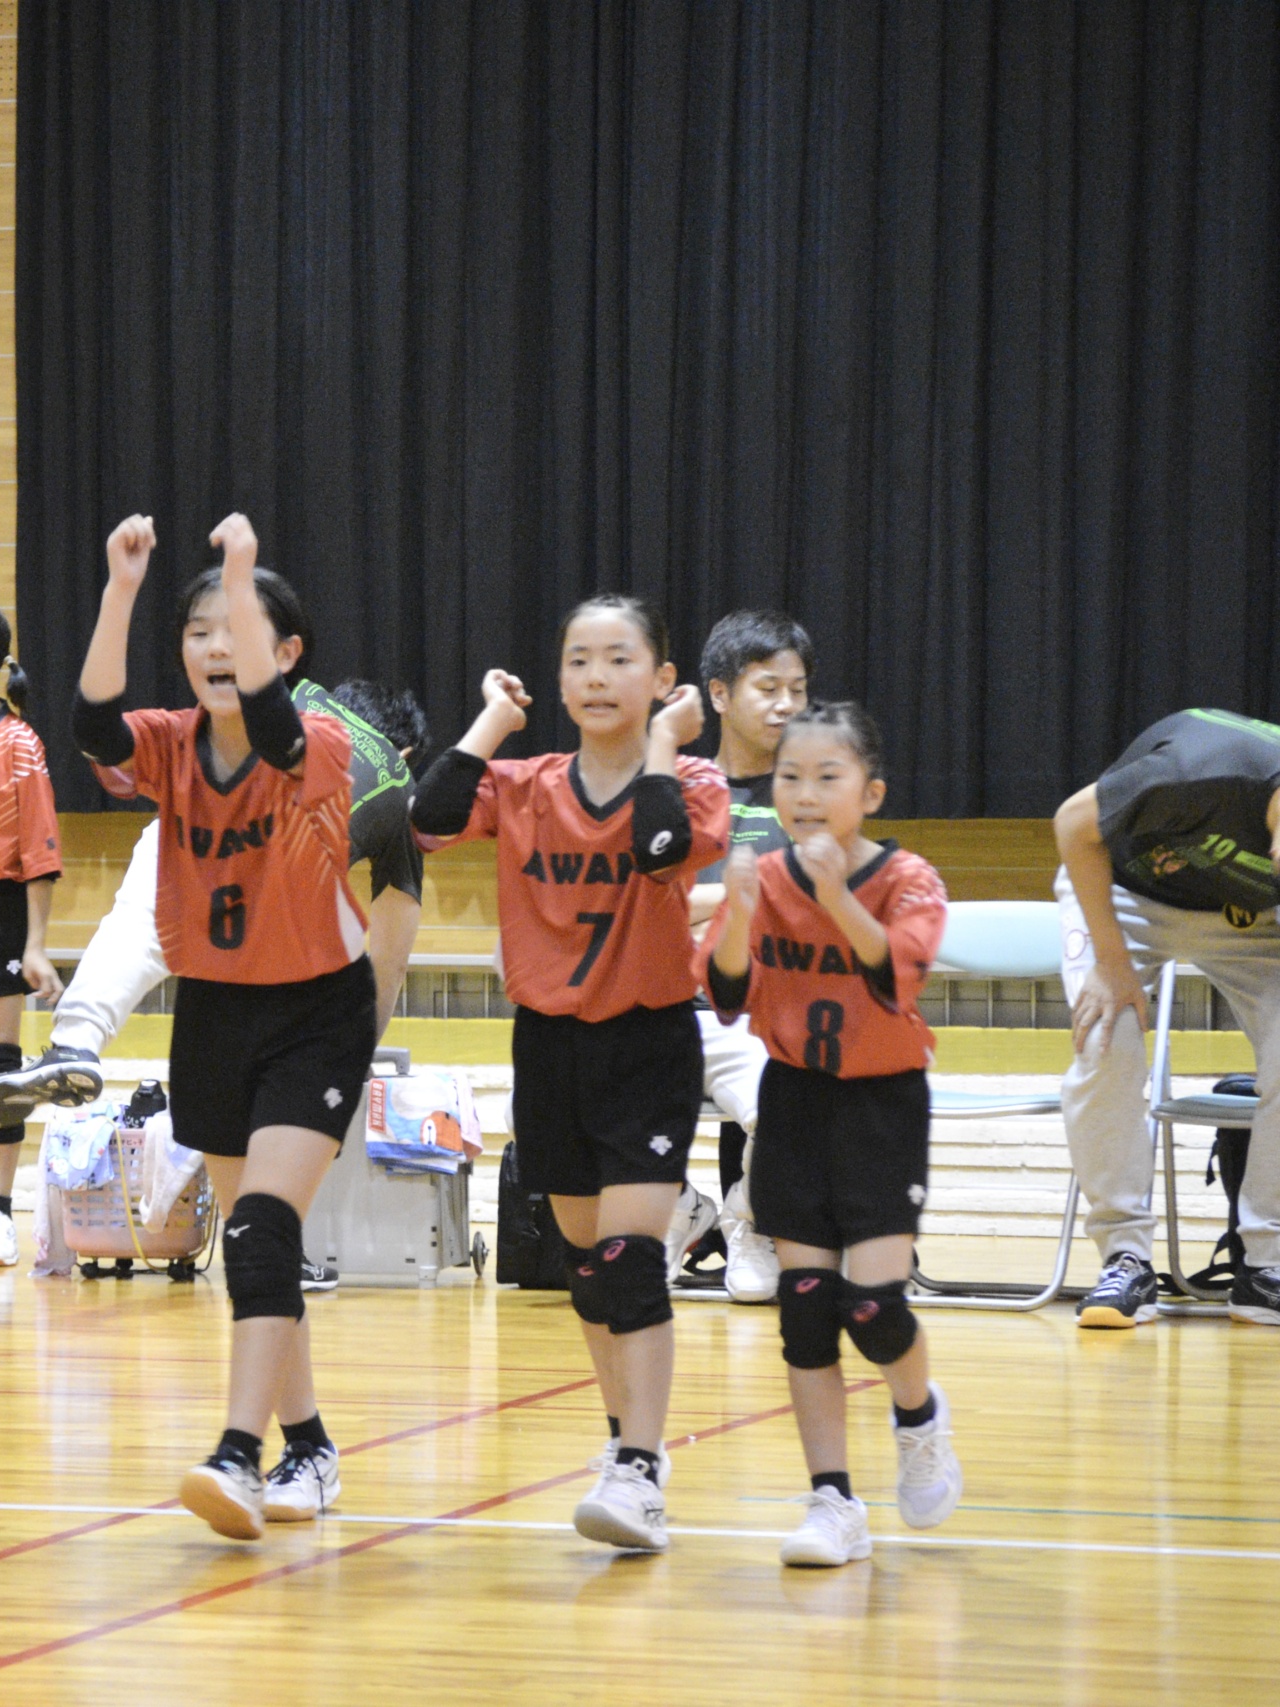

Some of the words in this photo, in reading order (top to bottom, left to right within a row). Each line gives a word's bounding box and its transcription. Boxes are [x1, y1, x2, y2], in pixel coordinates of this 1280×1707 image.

[208, 884, 246, 950] 6
[567, 912, 615, 987] 7
[804, 997, 844, 1076] 8
